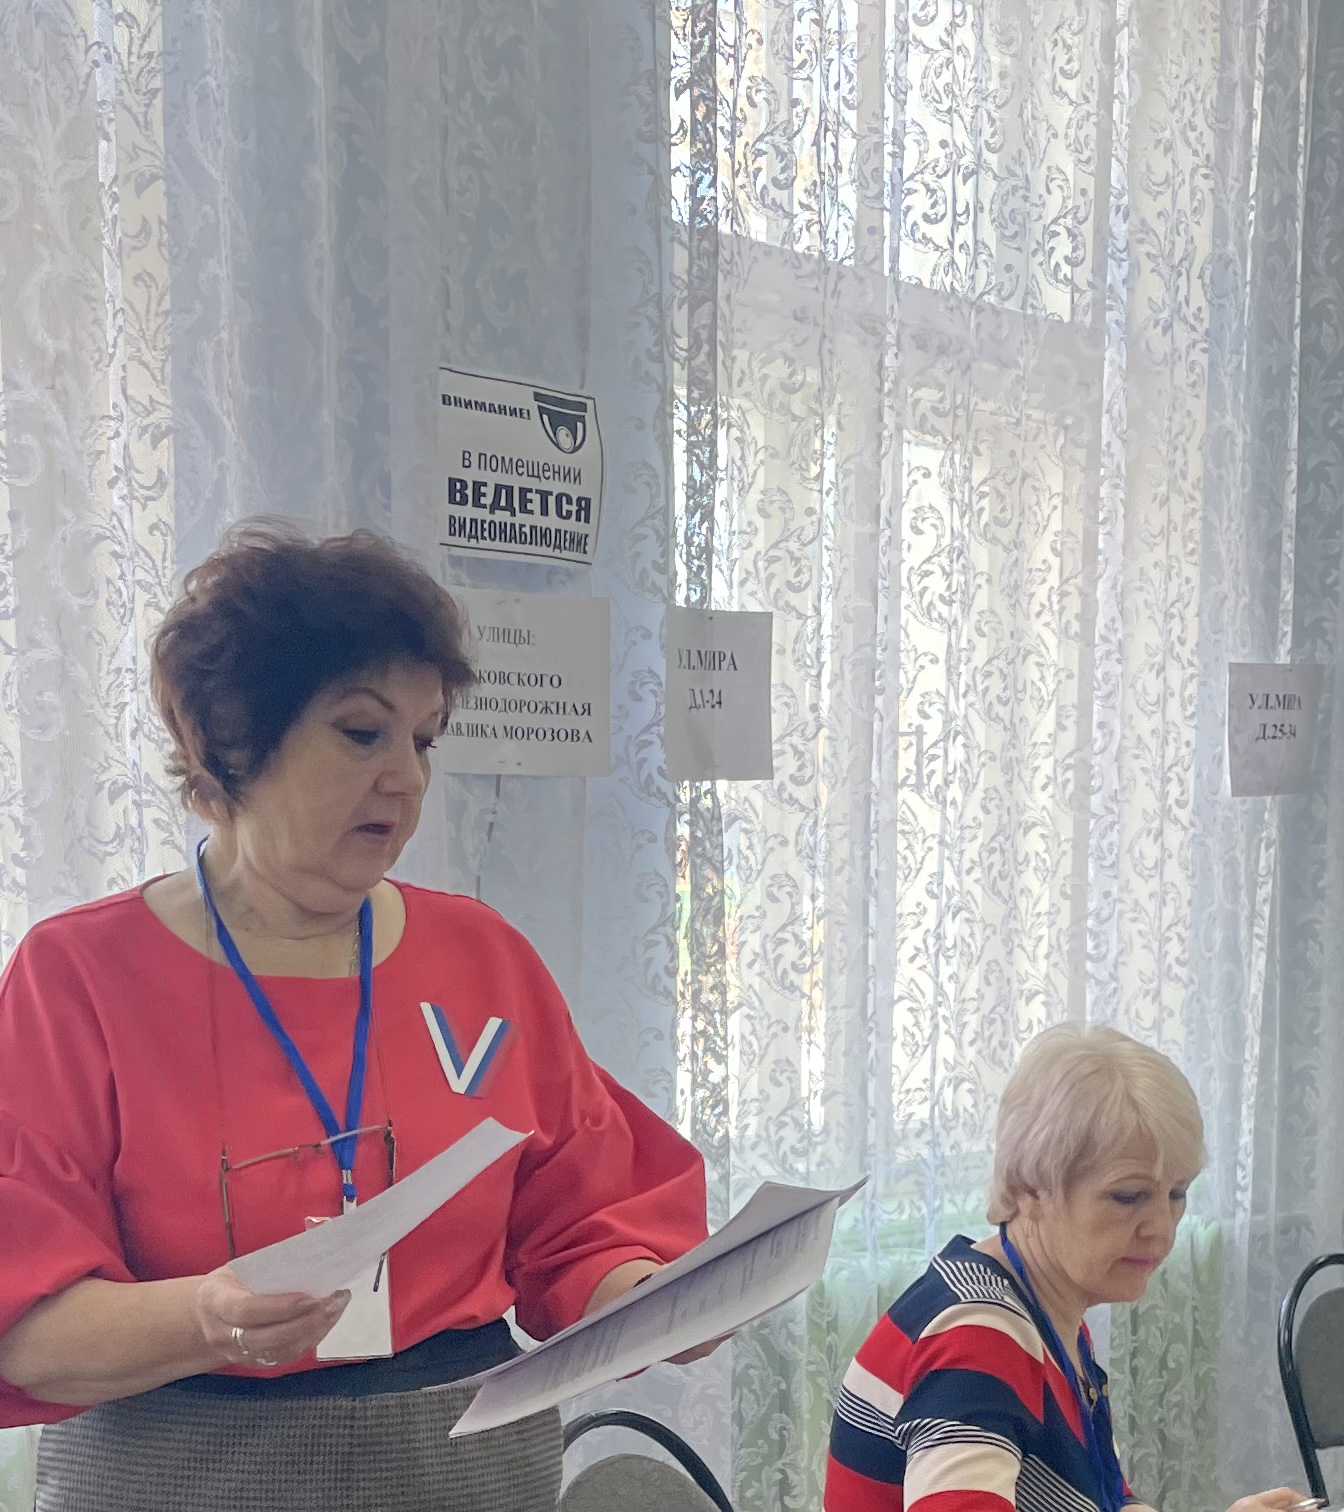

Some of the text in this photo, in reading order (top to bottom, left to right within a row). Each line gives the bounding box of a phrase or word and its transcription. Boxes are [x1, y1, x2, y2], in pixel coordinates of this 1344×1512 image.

[441, 393, 531, 420] ВНИМАНИЕ!
[462, 450, 582, 486] В помещении
[447, 476, 592, 524] ВЕДЕТСЯ
[448, 514, 590, 555] ВИДЕОНАБЛЮДЕНИЕ
[476, 625, 536, 648] УЛИЦЫ:
[443, 721, 594, 744] АВЛИКА МОРОЗОВА
